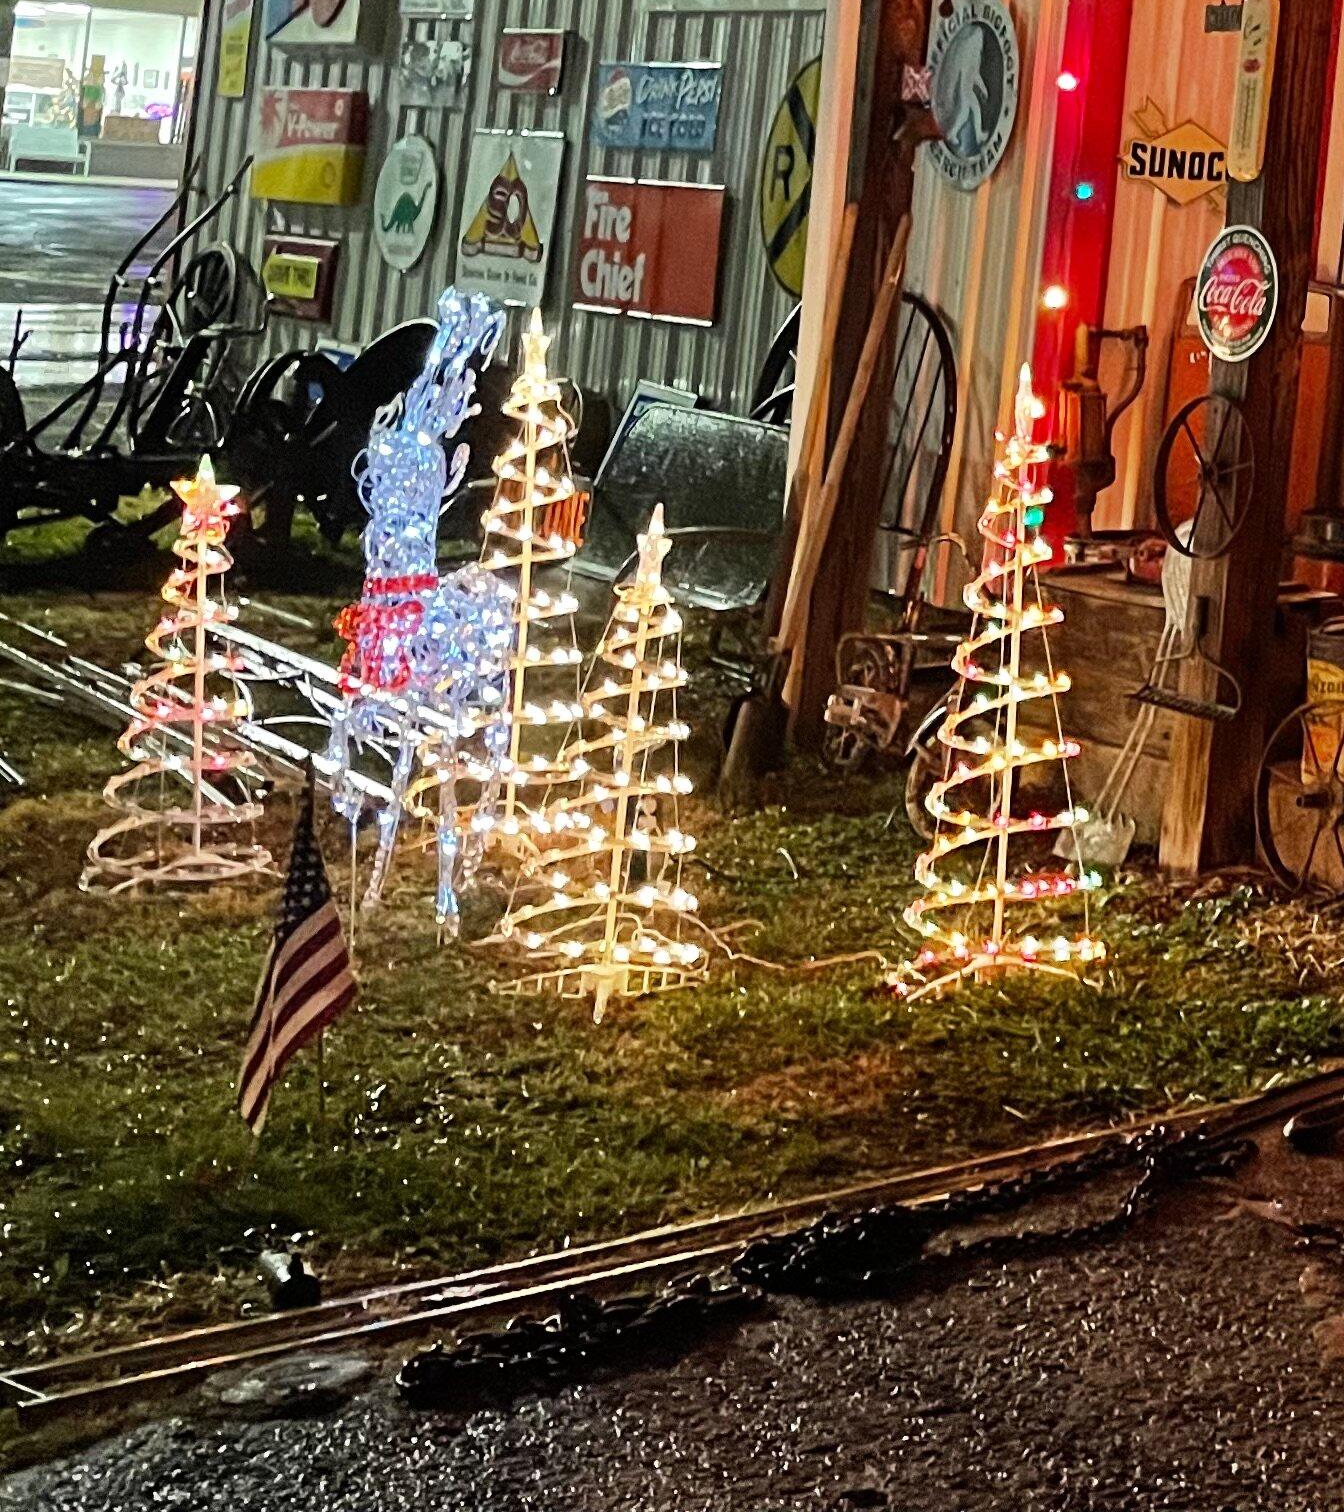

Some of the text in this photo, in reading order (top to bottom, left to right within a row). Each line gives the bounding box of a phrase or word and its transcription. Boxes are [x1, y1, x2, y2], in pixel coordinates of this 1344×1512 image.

[982, 4, 1015, 86] BIGFOOT
[1129, 141, 1230, 182] SUNOC
[583, 185, 634, 244] Fire
[579, 247, 647, 304] Chief
